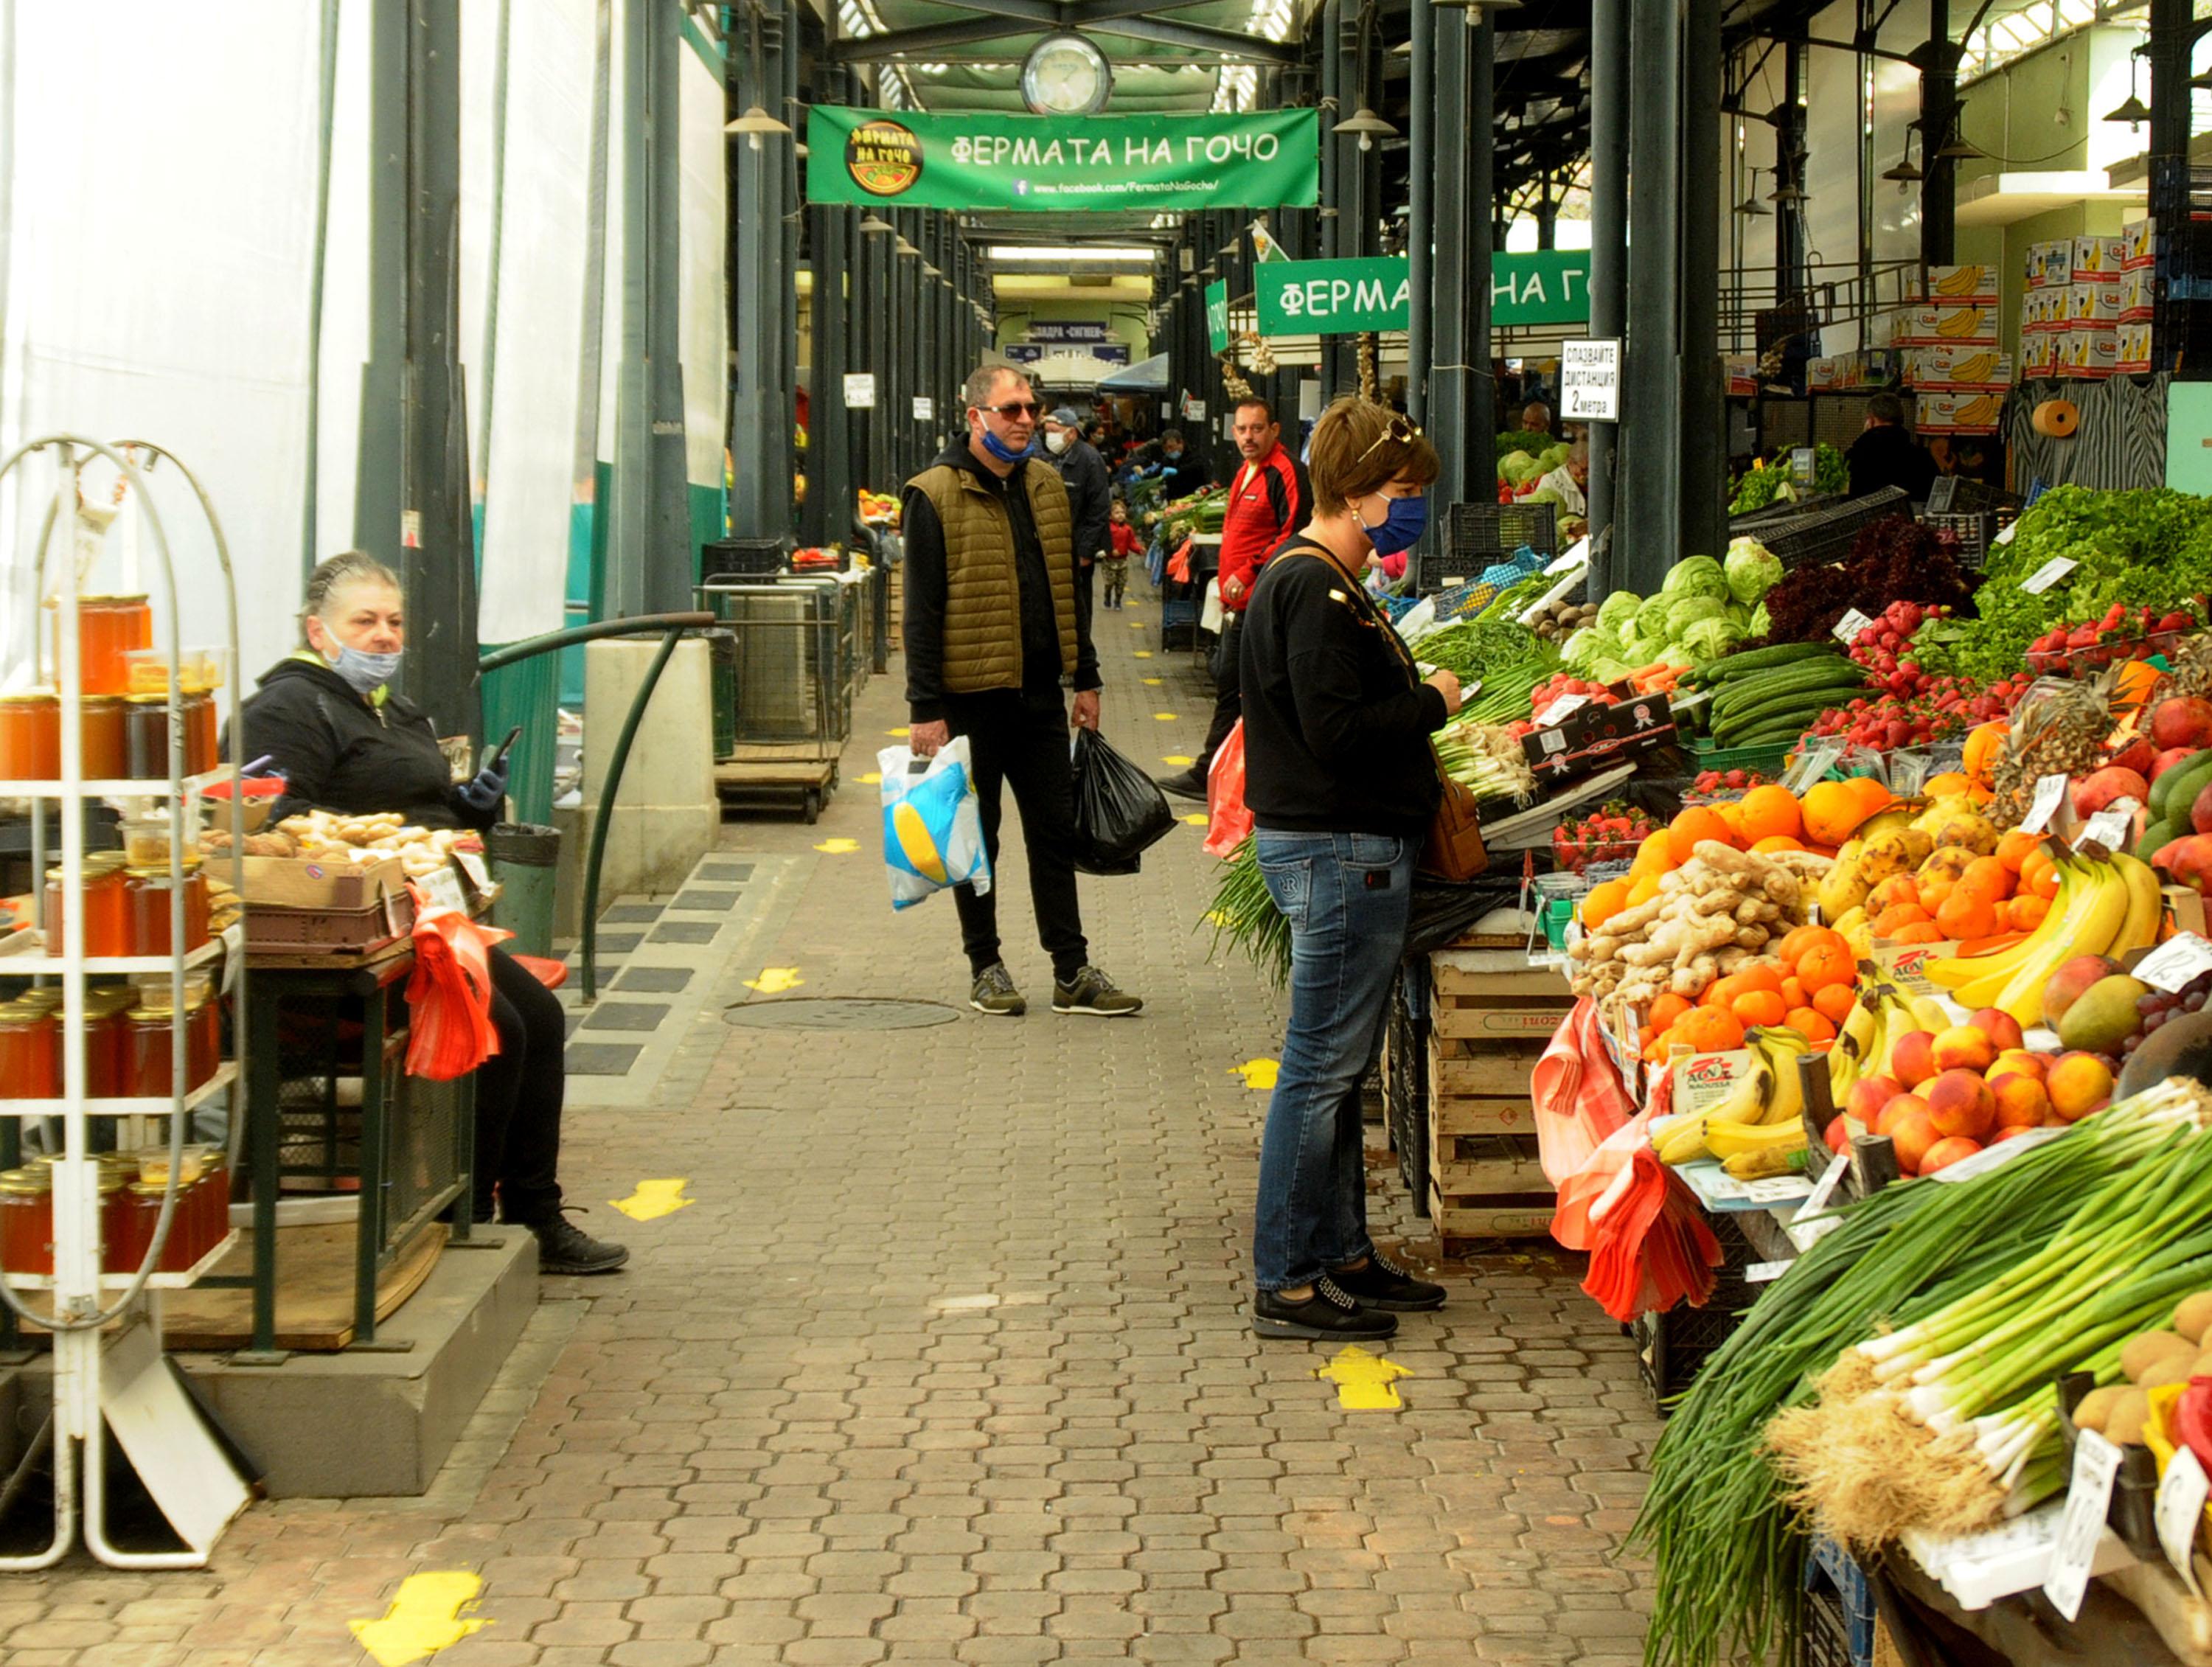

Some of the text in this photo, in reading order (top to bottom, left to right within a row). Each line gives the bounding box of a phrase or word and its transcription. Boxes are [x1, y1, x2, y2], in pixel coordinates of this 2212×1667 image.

[852, 128, 916, 147] ФЕРМАТА
[856, 147, 911, 163] НА ГОЧО
[951, 133, 1279, 166] ФЕРМАТА НА ГОЧО
[1491, 271, 1546, 307] НА
[1566, 346, 1615, 363] СПАЗВАЙТЕ
[1564, 370, 1615, 388] ДИСТАНЦИЯ
[1571, 390, 1607, 418] 2 метра
